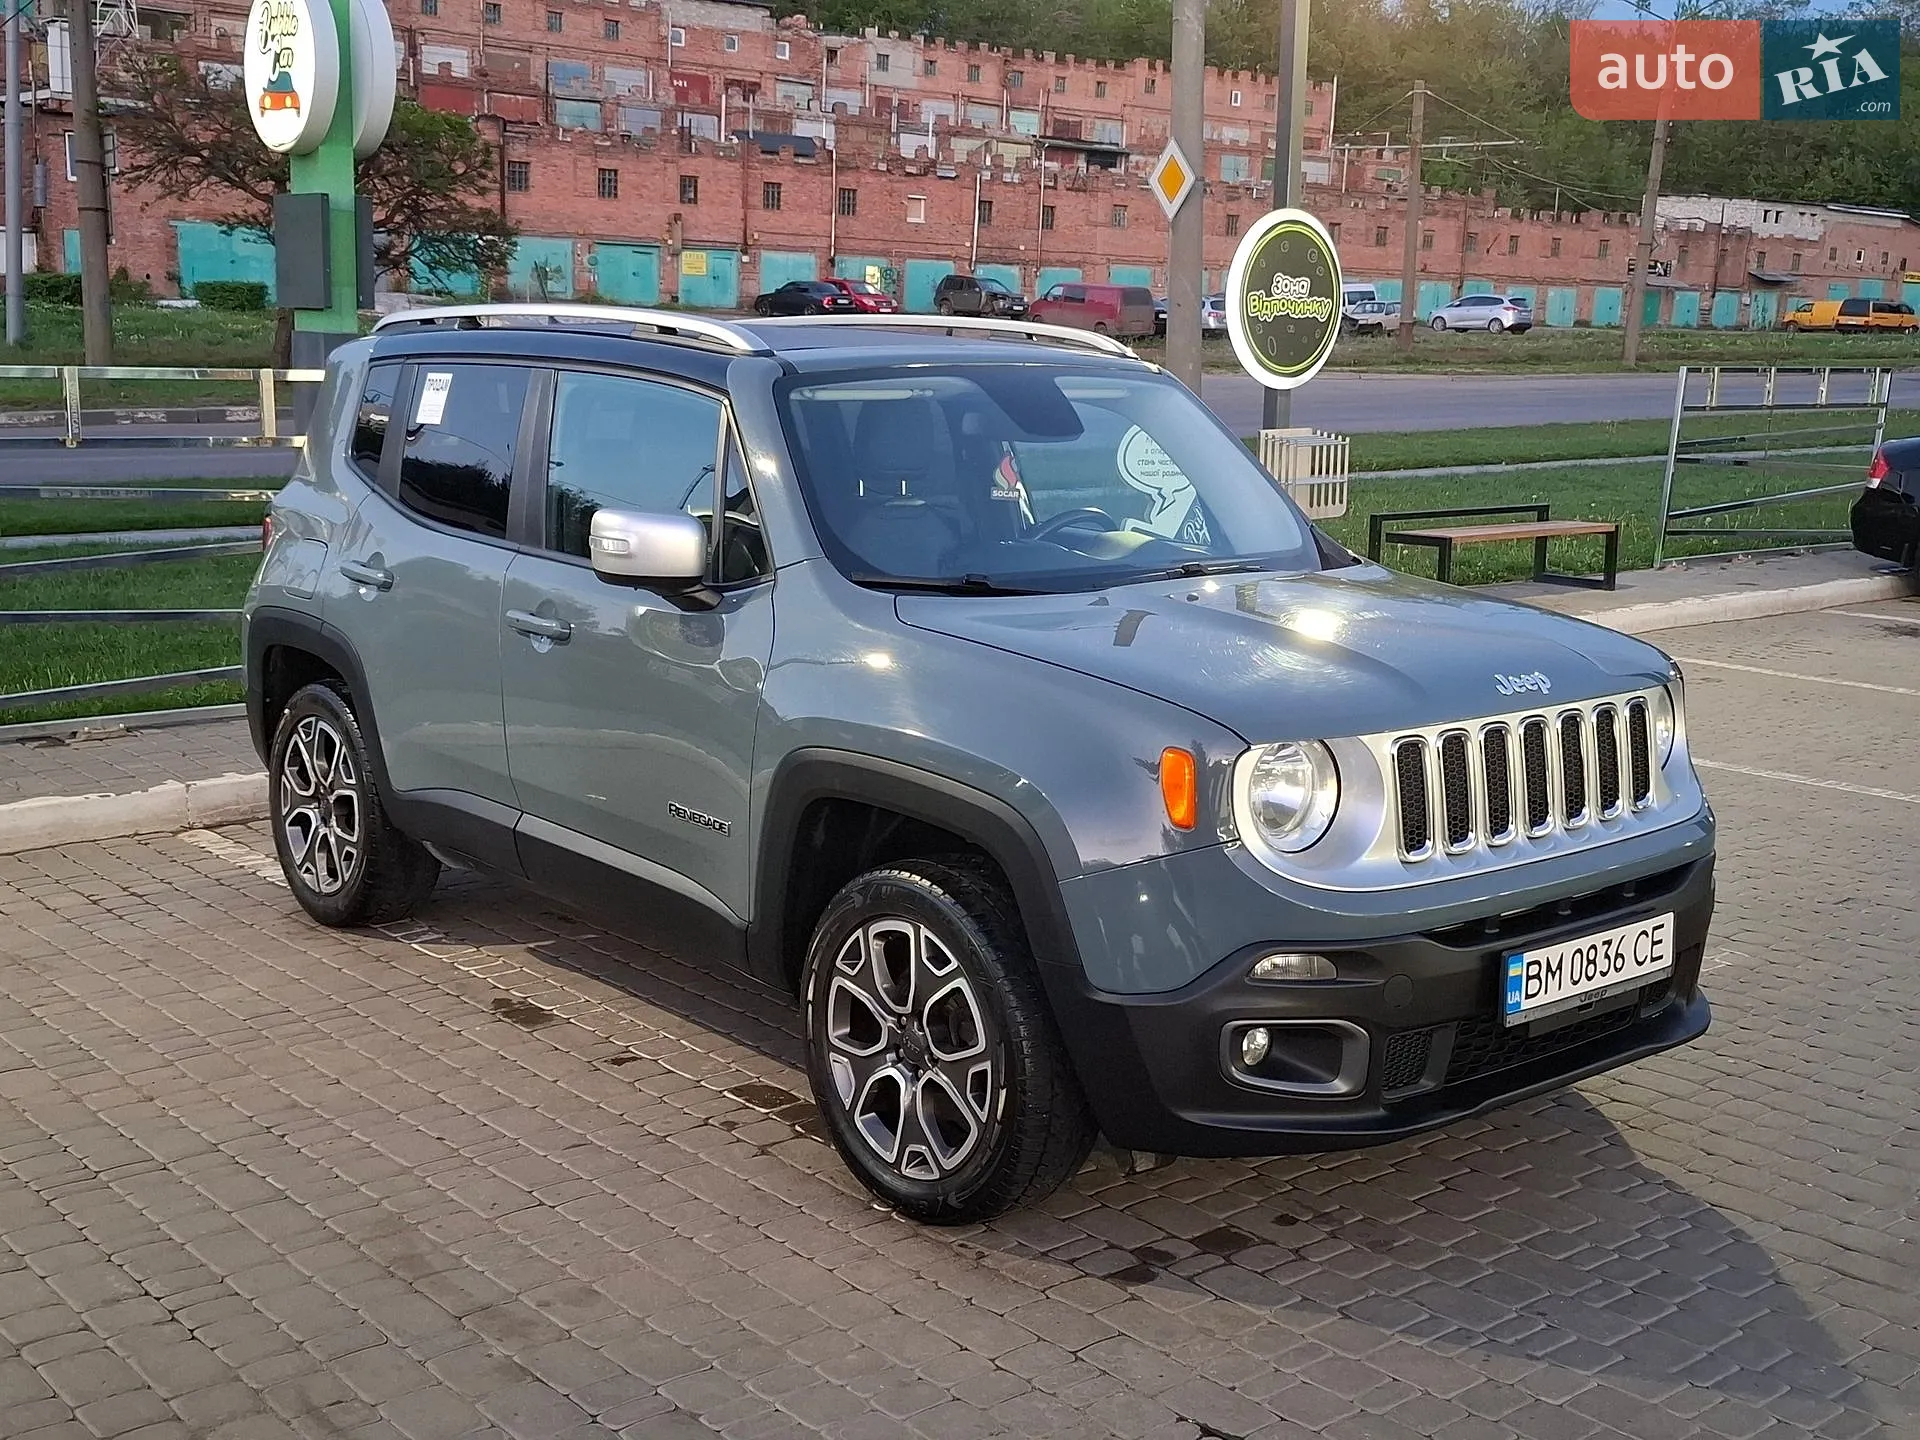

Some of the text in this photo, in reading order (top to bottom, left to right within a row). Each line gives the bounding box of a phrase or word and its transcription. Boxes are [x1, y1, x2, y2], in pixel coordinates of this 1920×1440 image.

[1272, 274, 1309, 296] Зона
[1249, 292, 1331, 320] Відпочинку
[1494, 672, 1551, 695] Jeep
[668, 801, 731, 836] RENEGADE
[1524, 923, 1665, 1000] BM 0836 CE
[1507, 991, 1521, 1004] UA
